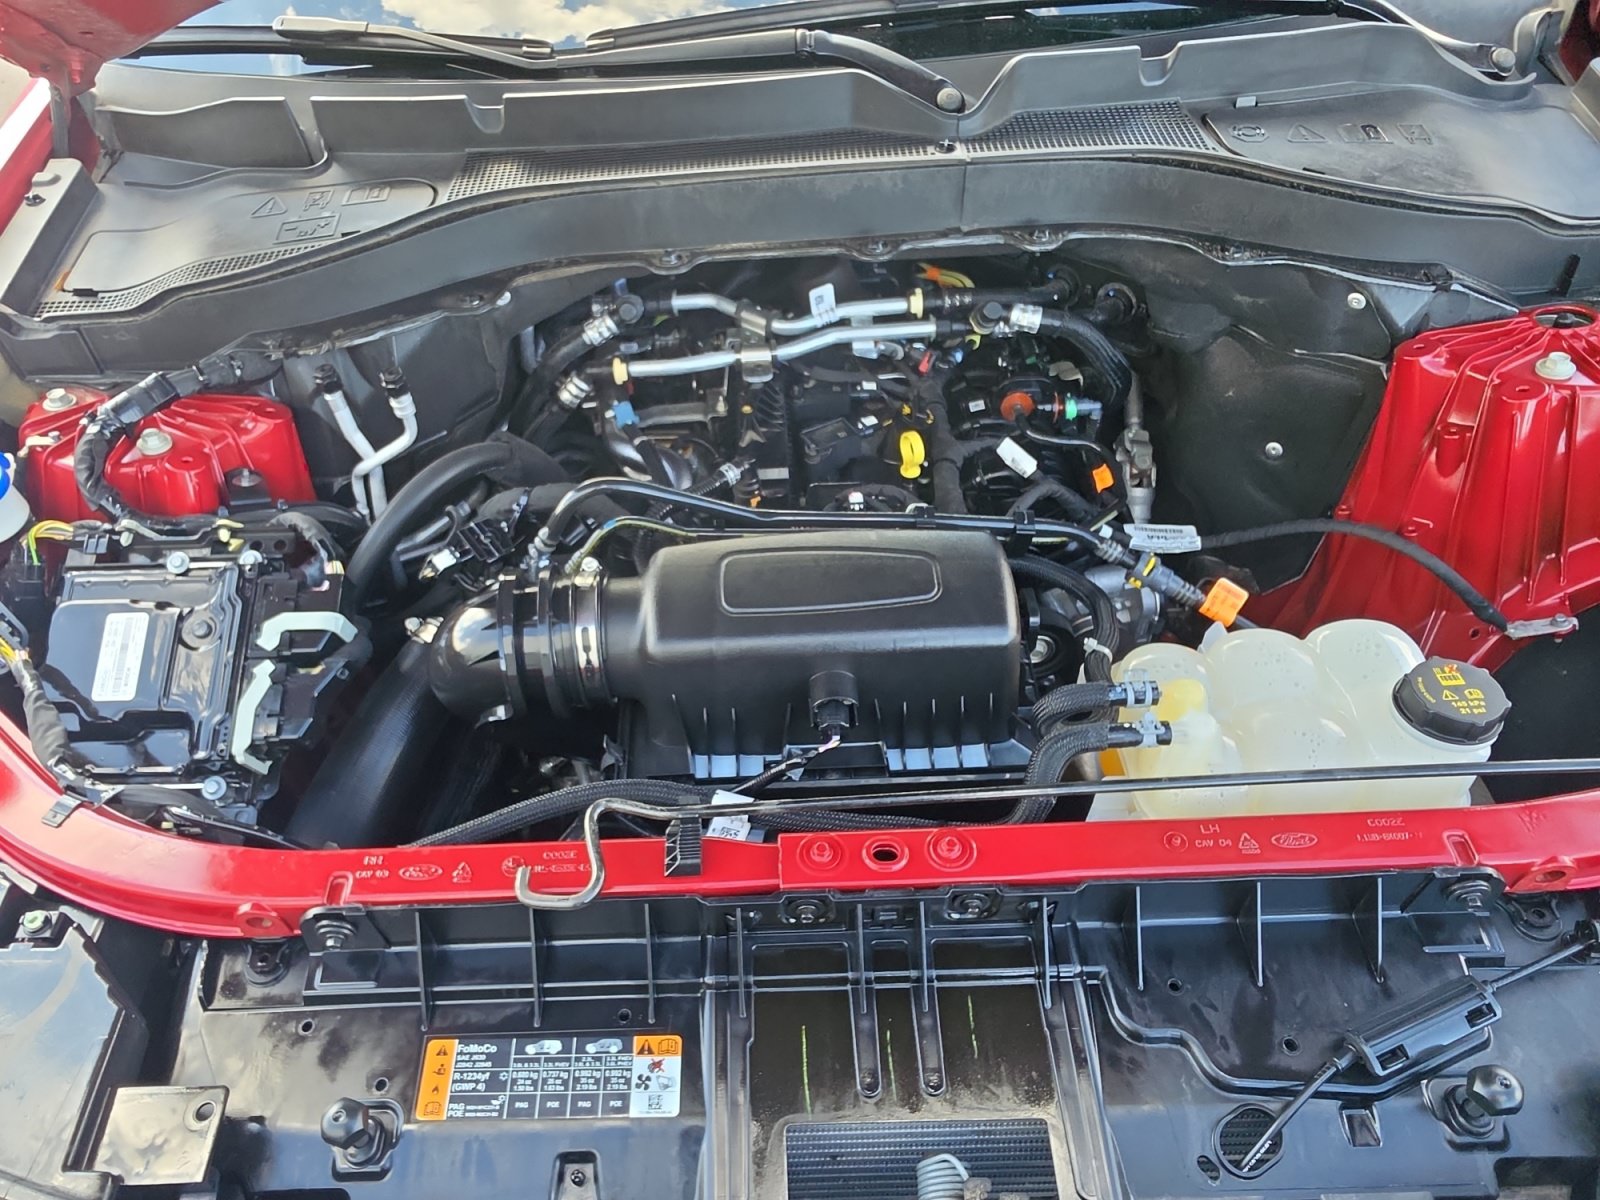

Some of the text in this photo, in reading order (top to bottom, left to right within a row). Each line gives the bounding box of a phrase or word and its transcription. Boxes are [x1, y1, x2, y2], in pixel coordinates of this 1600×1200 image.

[1200, 823, 1220, 834] LH
[1195, 839, 1214, 848] CAV
[457, 1043, 498, 1053] FoMoCo
[453, 1071, 490, 1081] R-1234yf
[560, 1071, 569, 1080] kg
[592, 1070, 601, 1079] kg
[622, 1070, 631, 1078] kg
[448, 1102, 465, 1110] PAG
[447, 1110, 465, 1118] POE
